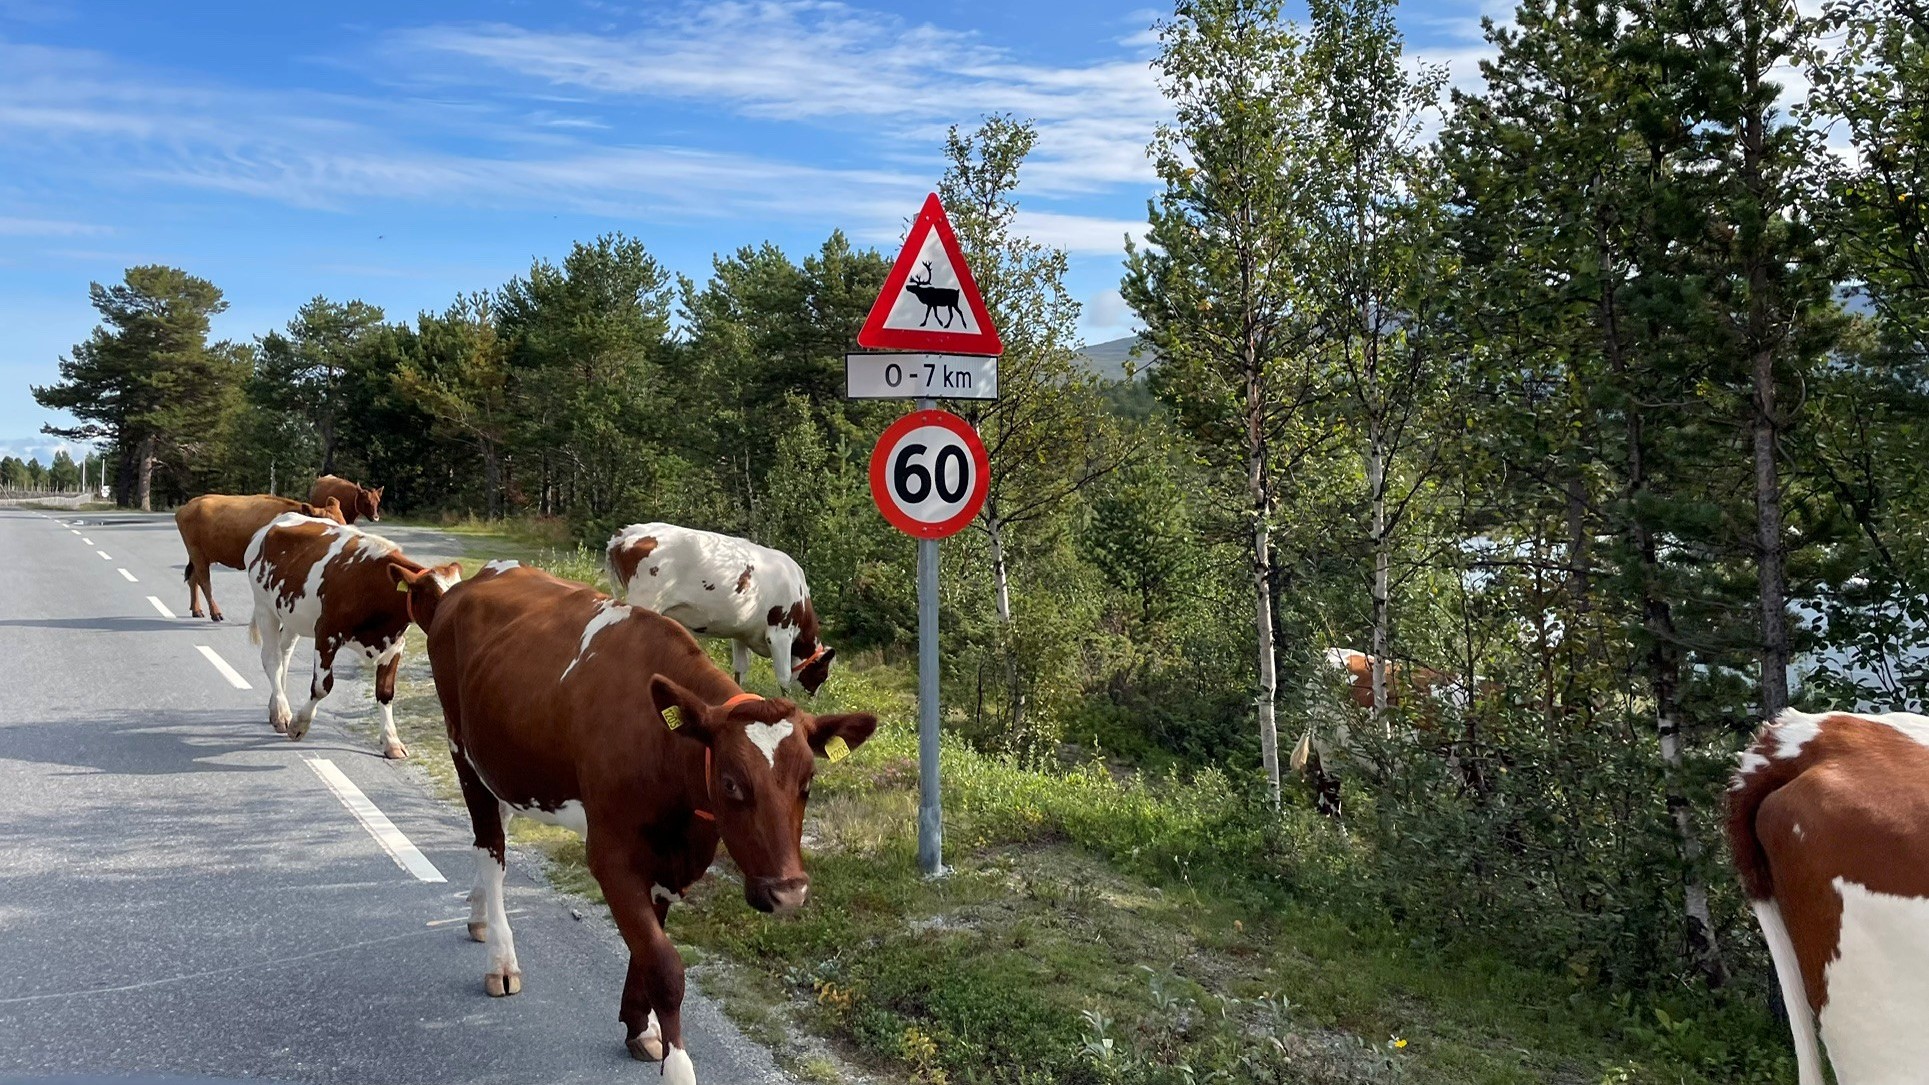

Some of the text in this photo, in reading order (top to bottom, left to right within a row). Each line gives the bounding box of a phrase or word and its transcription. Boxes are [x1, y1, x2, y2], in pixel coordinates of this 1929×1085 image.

[943, 364, 972, 389] km
[893, 443, 970, 504] 60
[663, 708, 681, 729] 1205
[830, 744, 849, 761] 1205
